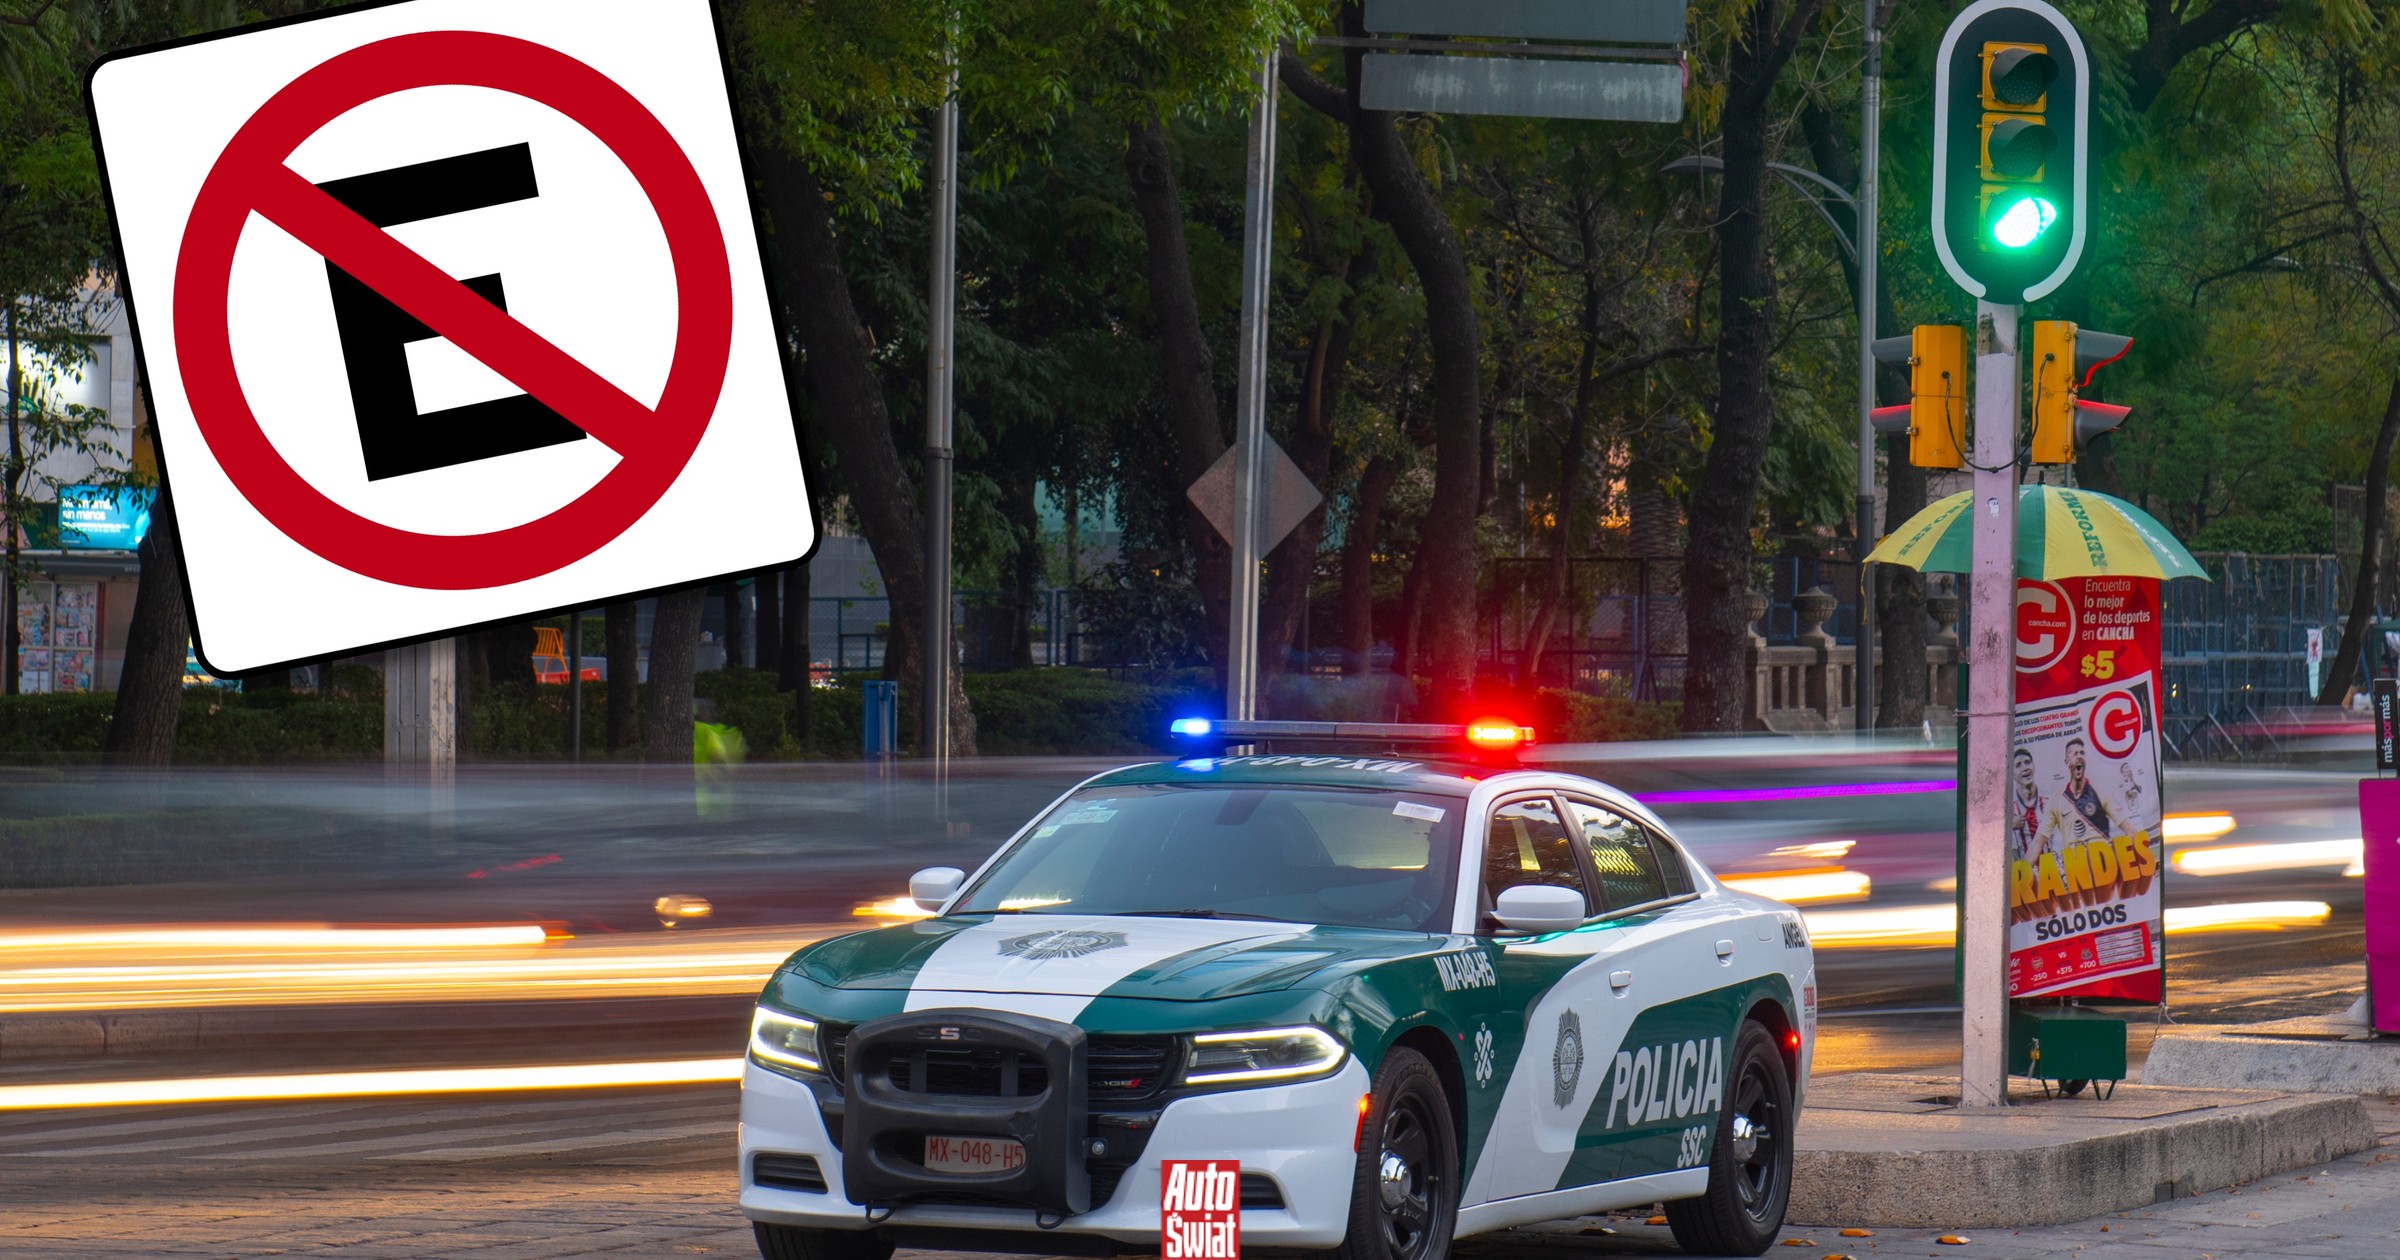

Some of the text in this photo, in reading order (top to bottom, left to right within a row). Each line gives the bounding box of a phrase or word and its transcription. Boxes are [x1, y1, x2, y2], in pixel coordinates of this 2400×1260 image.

[2056, 490, 2109, 567] REFORMA
[2084, 595, 2125, 610] lo mejor
[2085, 579, 2131, 592] Encuentra
[2028, 619, 2067, 628] cancha.com
[2082, 626, 2135, 641] en CANCHA
[2083, 610, 2151, 625] de los deportes
[2080, 650, 2115, 680] $5
[2093, 697, 2135, 752] C
[2380, 694, 2395, 763] máspormás
[2011, 831, 2156, 908] RANDES
[2036, 904, 2127, 941] SÓLO DOS
[1433, 951, 1496, 992] MX-048-H5
[2079, 959, 2097, 970] +700
[1605, 1036, 1723, 1130] POLICIA
[929, 1136, 1025, 1169] MX-048-H5
[1677, 1125, 1707, 1169] SSC
